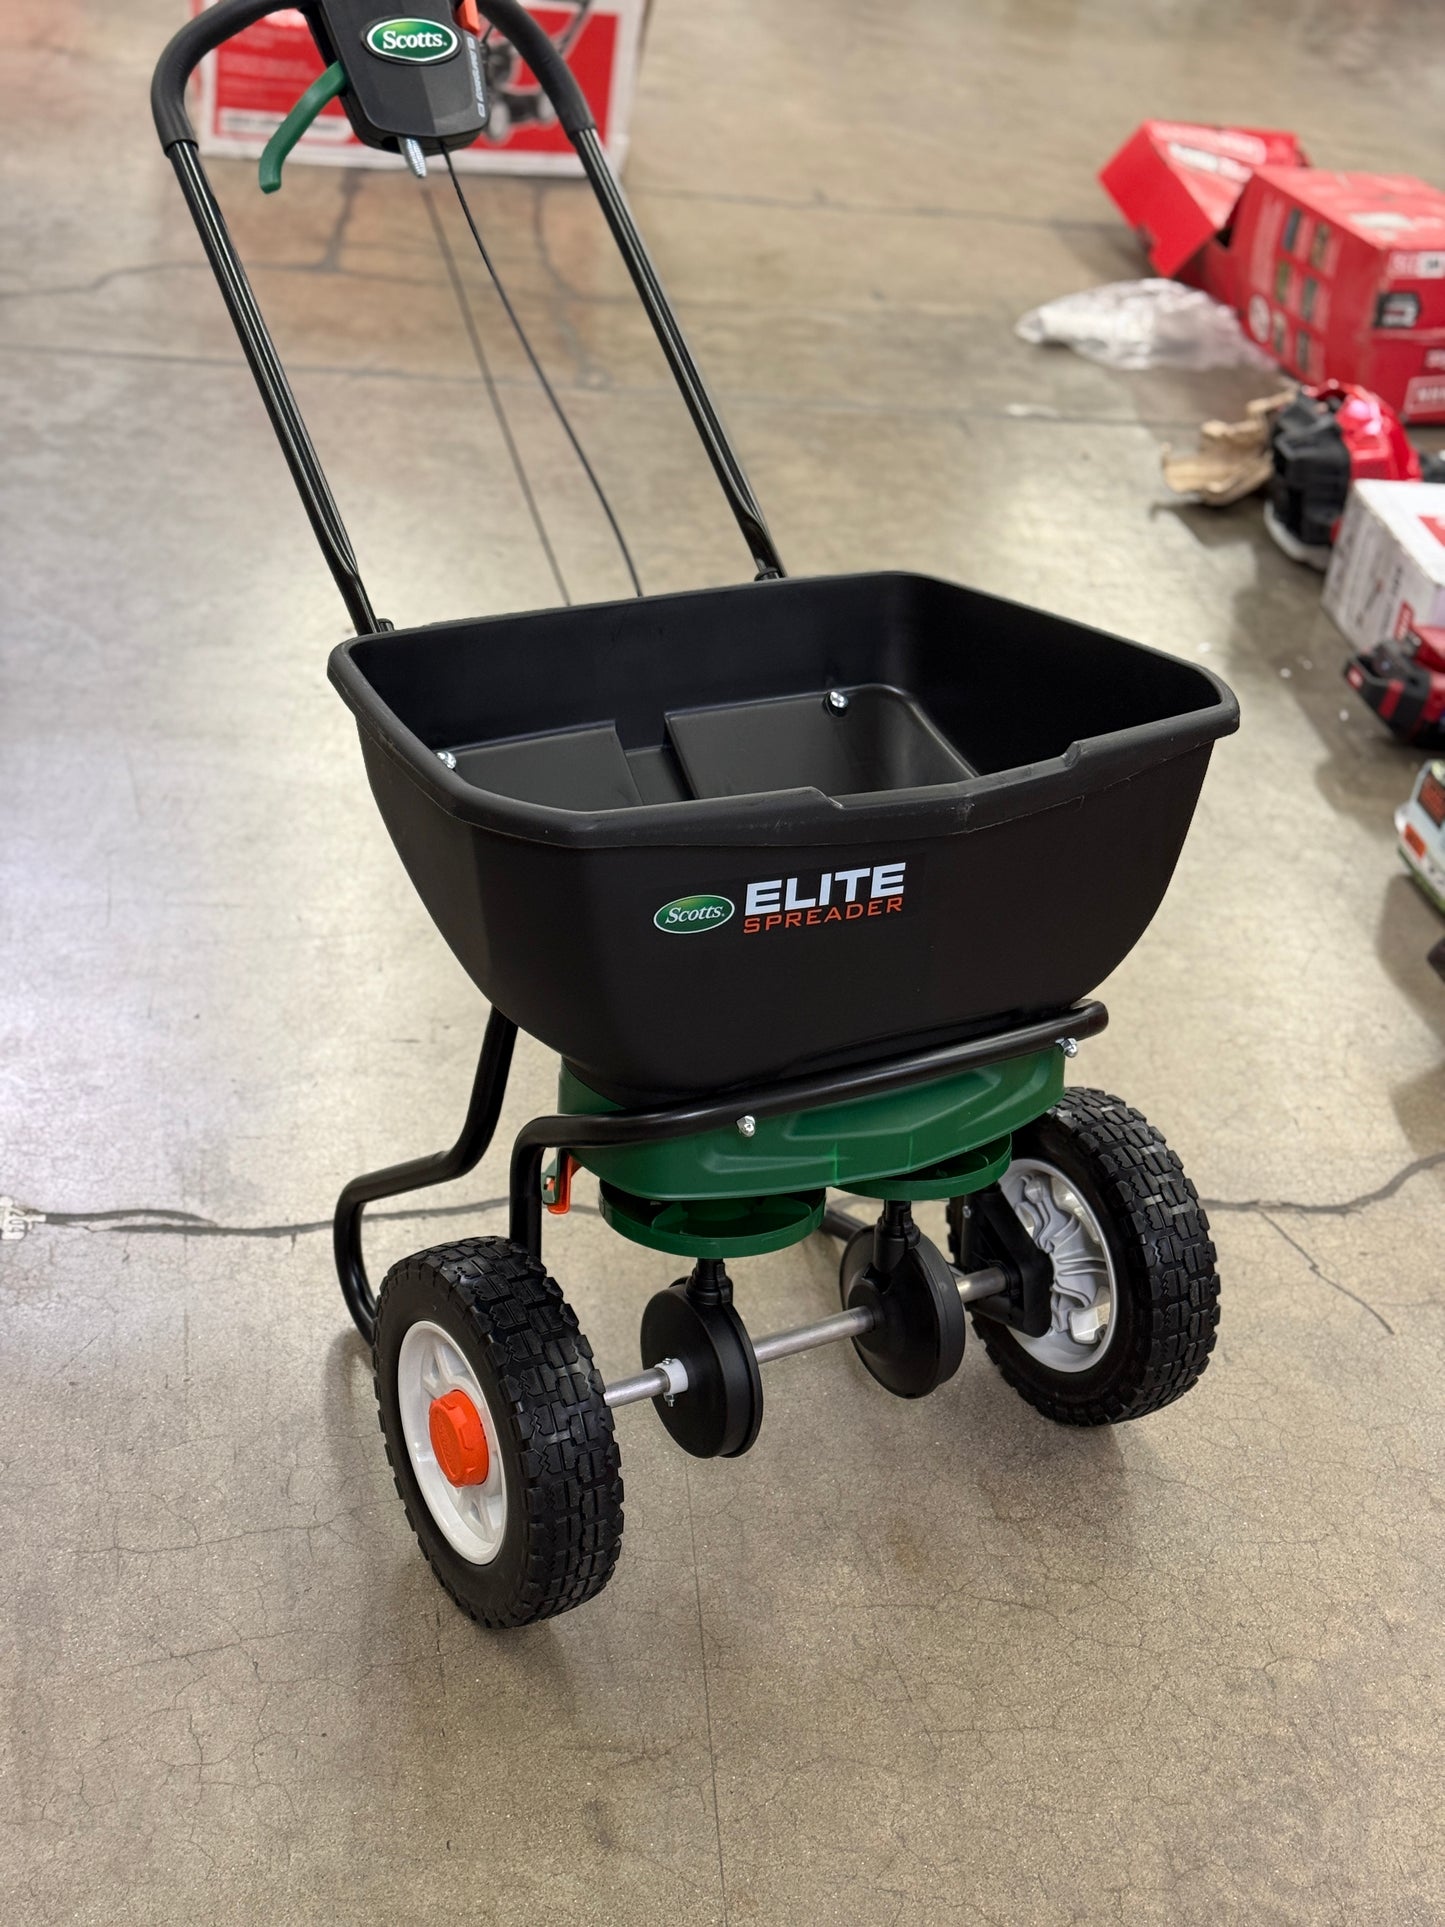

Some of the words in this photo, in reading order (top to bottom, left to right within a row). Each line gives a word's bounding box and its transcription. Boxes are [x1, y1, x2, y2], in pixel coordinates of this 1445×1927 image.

[383, 31, 442, 49] Scotts
[745, 862, 906, 916] ELITE
[664, 905, 723, 925] Scotts
[743, 896, 904, 934] SPREADER
